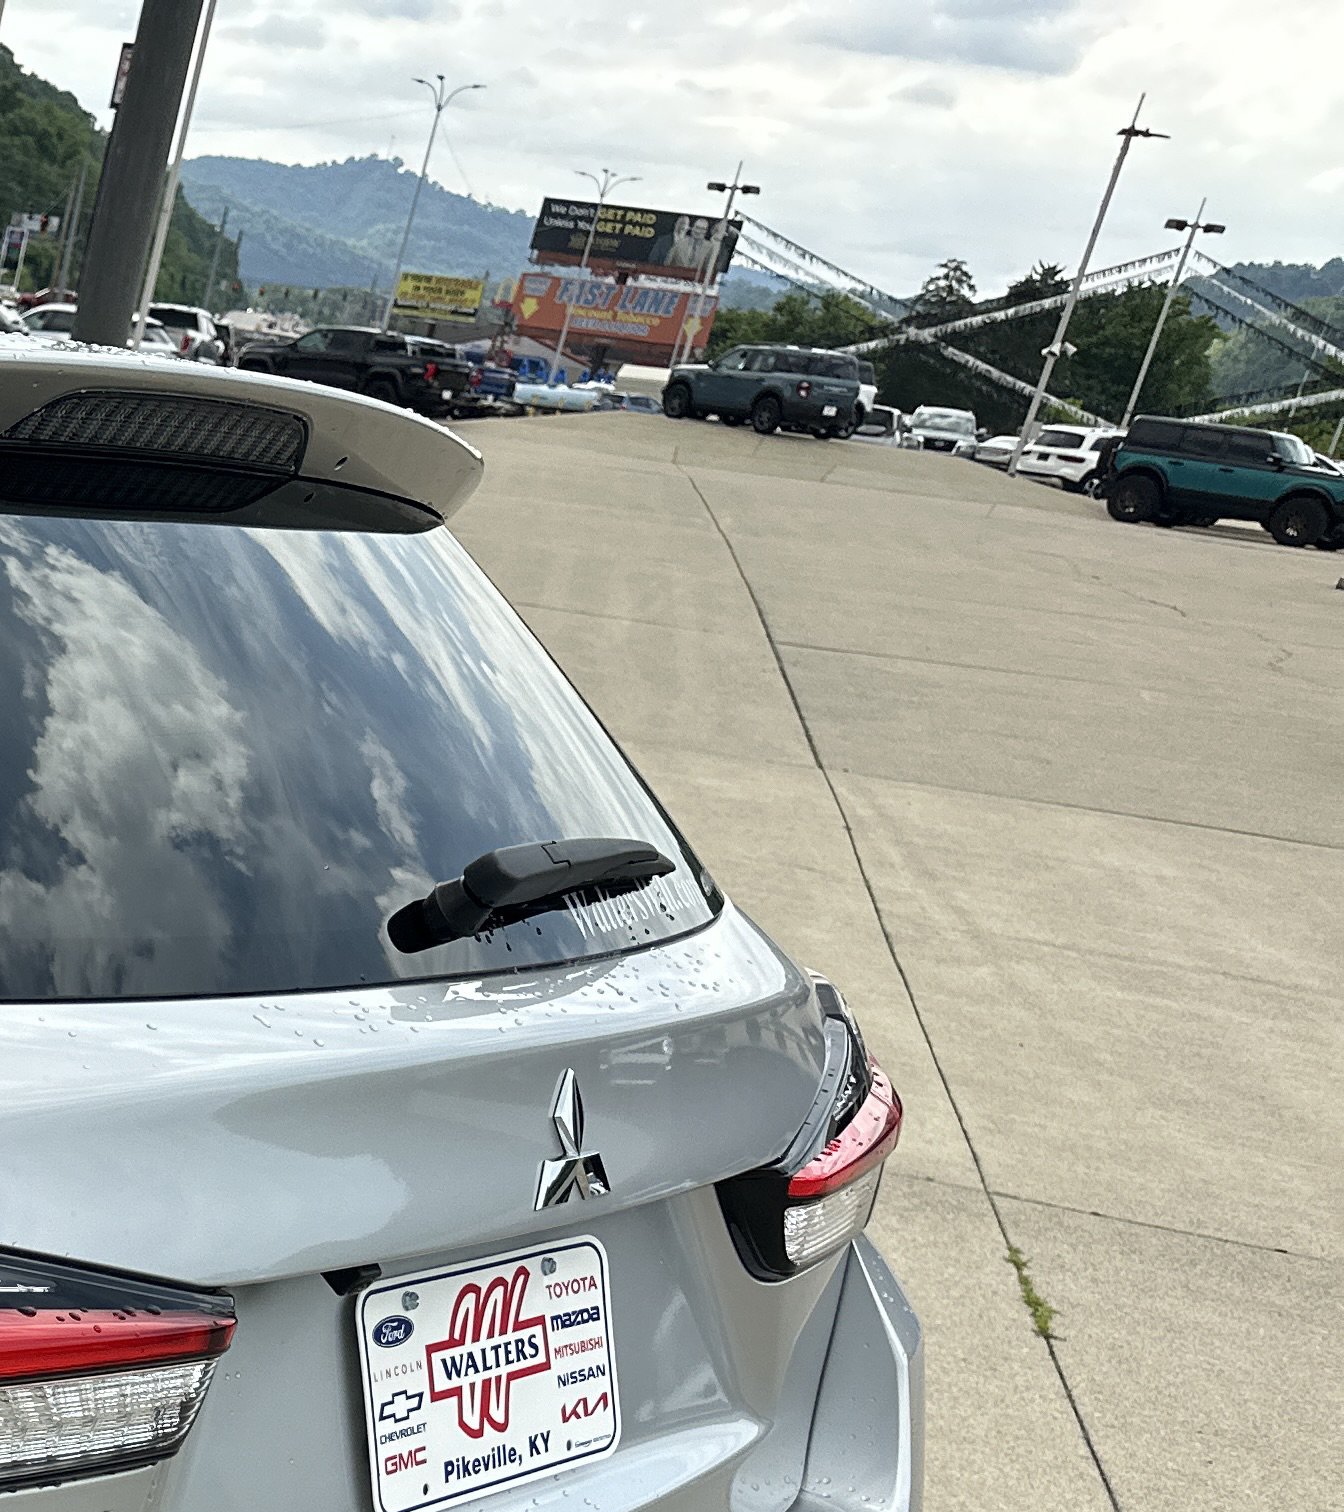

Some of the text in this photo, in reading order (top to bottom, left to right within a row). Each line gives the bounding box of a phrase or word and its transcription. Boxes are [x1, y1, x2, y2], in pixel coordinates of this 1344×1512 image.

[596, 221, 623, 235] GET
[624, 223, 656, 238] PAID
[626, 210, 657, 225] PAID
[616, 286, 680, 318] LANE
[546, 1275, 598, 1300] TOYOTA
[380, 1321, 407, 1342] Ford
[440, 1333, 541, 1382] WALTERS
[554, 1336, 604, 1360] MITSUBISHI
[373, 1360, 423, 1383] LINCOLN
[557, 1364, 606, 1388] NISSAN
[379, 1422, 428, 1446] CHEVROLET
[384, 1446, 427, 1476] GMC
[443, 1429, 552, 1484] Pikeville, KY
